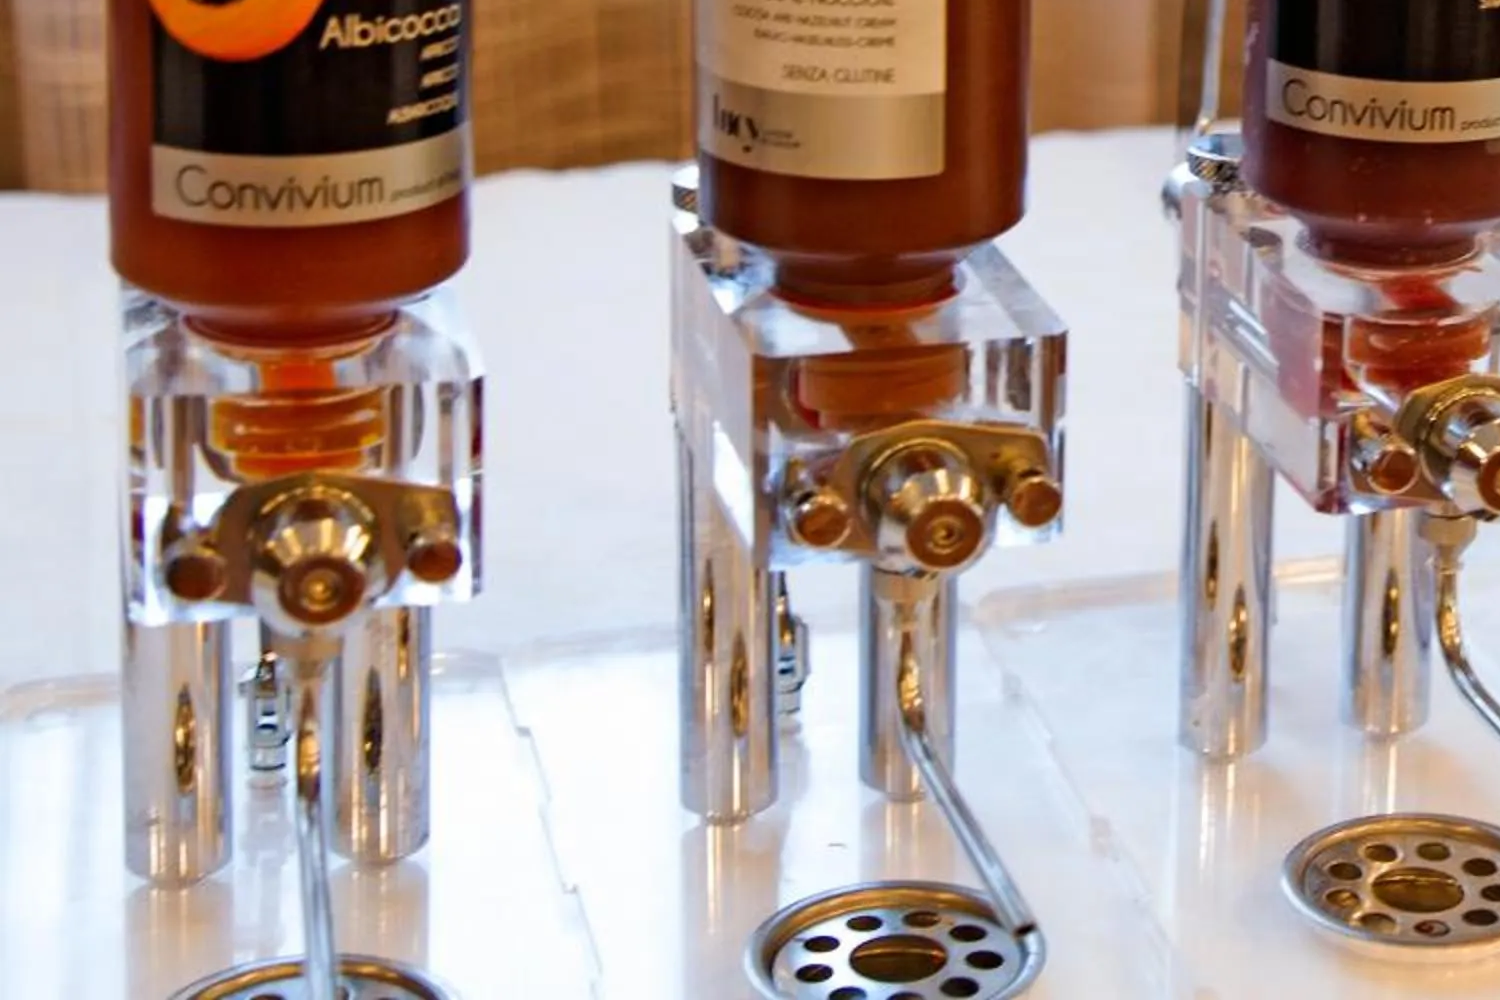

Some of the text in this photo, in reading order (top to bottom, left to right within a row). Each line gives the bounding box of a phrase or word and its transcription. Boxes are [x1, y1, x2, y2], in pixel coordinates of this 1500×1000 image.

[319, 3, 461, 50] Albicocca
[1282, 78, 1455, 131] Convivium
[175, 164, 384, 211] Convivium
